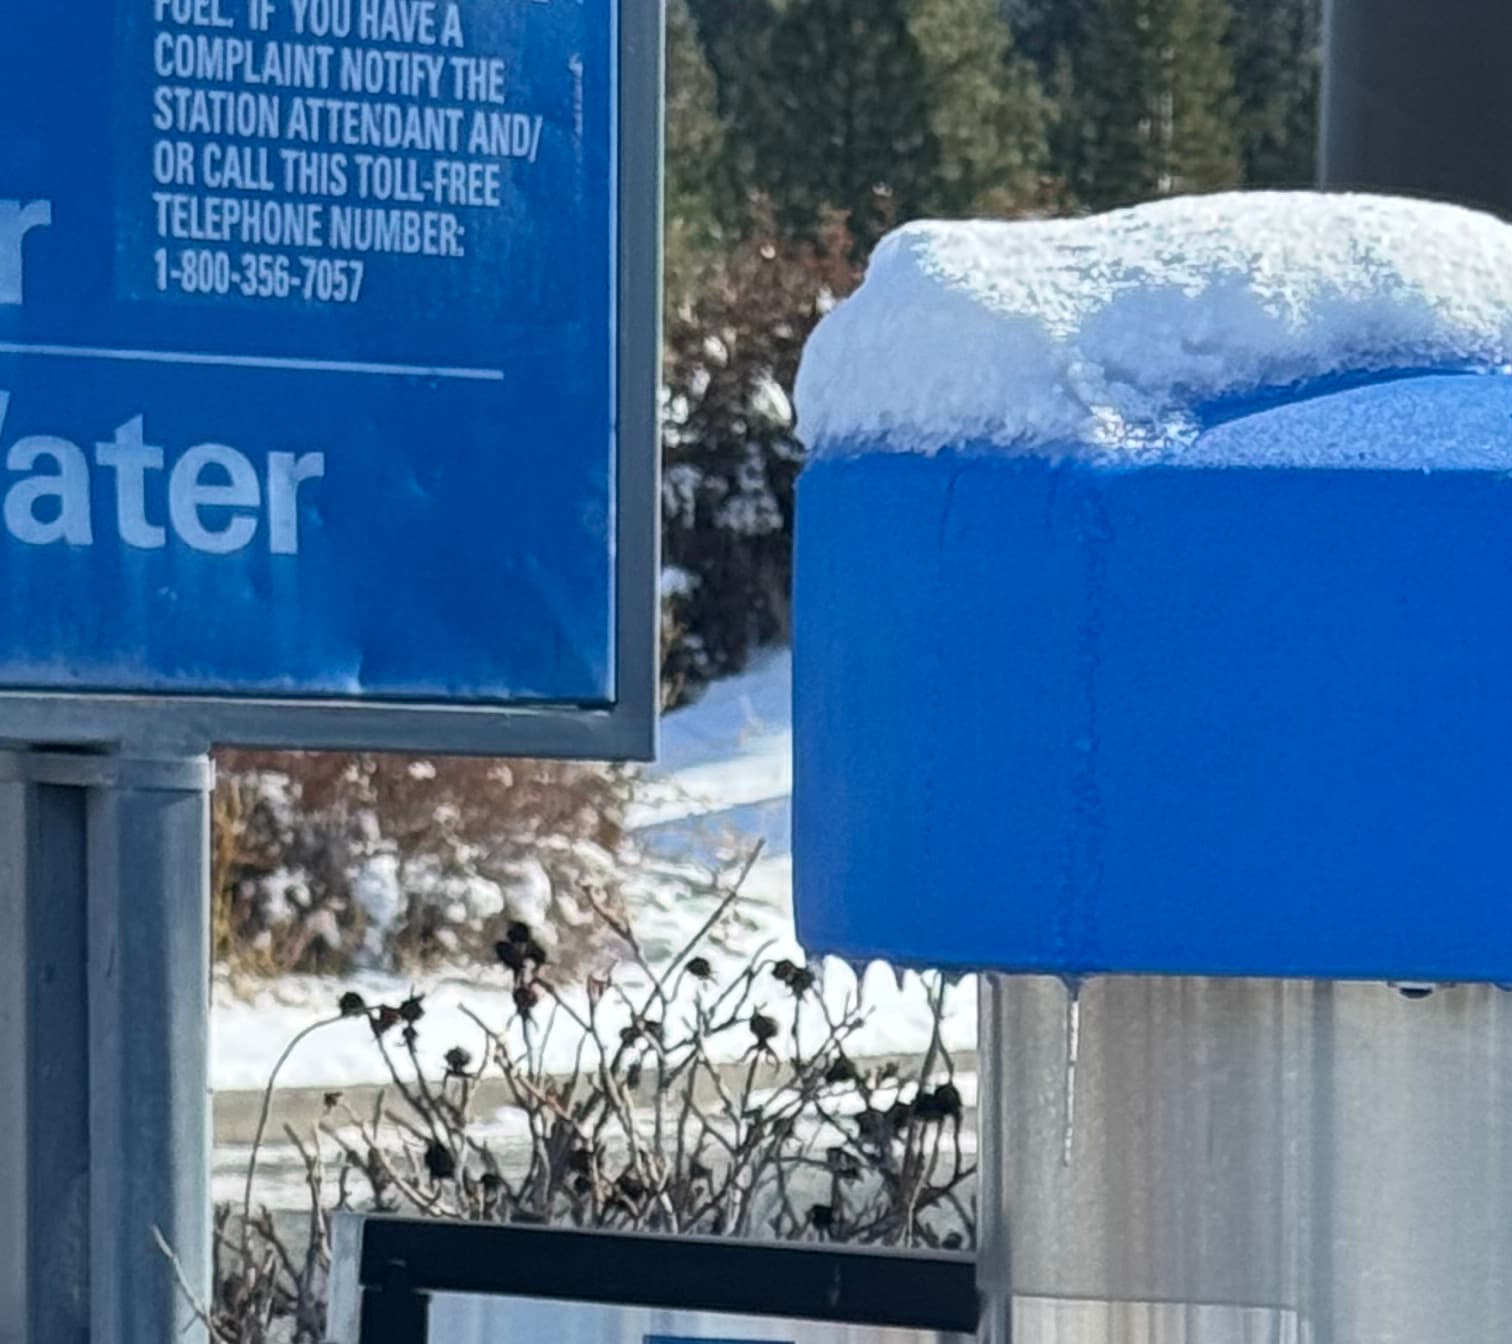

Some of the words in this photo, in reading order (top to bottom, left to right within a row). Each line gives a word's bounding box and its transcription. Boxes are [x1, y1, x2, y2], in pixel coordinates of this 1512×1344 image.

[249, 0, 275, 32] IF
[291, 0, 350, 38] YOU
[360, 0, 436, 45] HAVE
[440, 3, 464, 48] A
[154, 31, 335, 89] COMPLAINT
[340, 46, 445, 99] NOTIFY
[451, 55, 505, 104] THE
[153, 85, 280, 138] STATION
[286, 95, 464, 154] ATTENDANT
[468, 108, 543, 163] AND/
[154, 139, 195, 186] OR
[202, 142, 275, 191] CALL
[281, 148, 348, 197] THIS
[355, 153, 501, 207] TOLL-FREE
[153, 192, 323, 248] TELEPHONE
[329, 204, 466, 258] NUMBER:
[154, 247, 364, 303] 1-800-356-7057
[0, 389, 326, 556] ater
